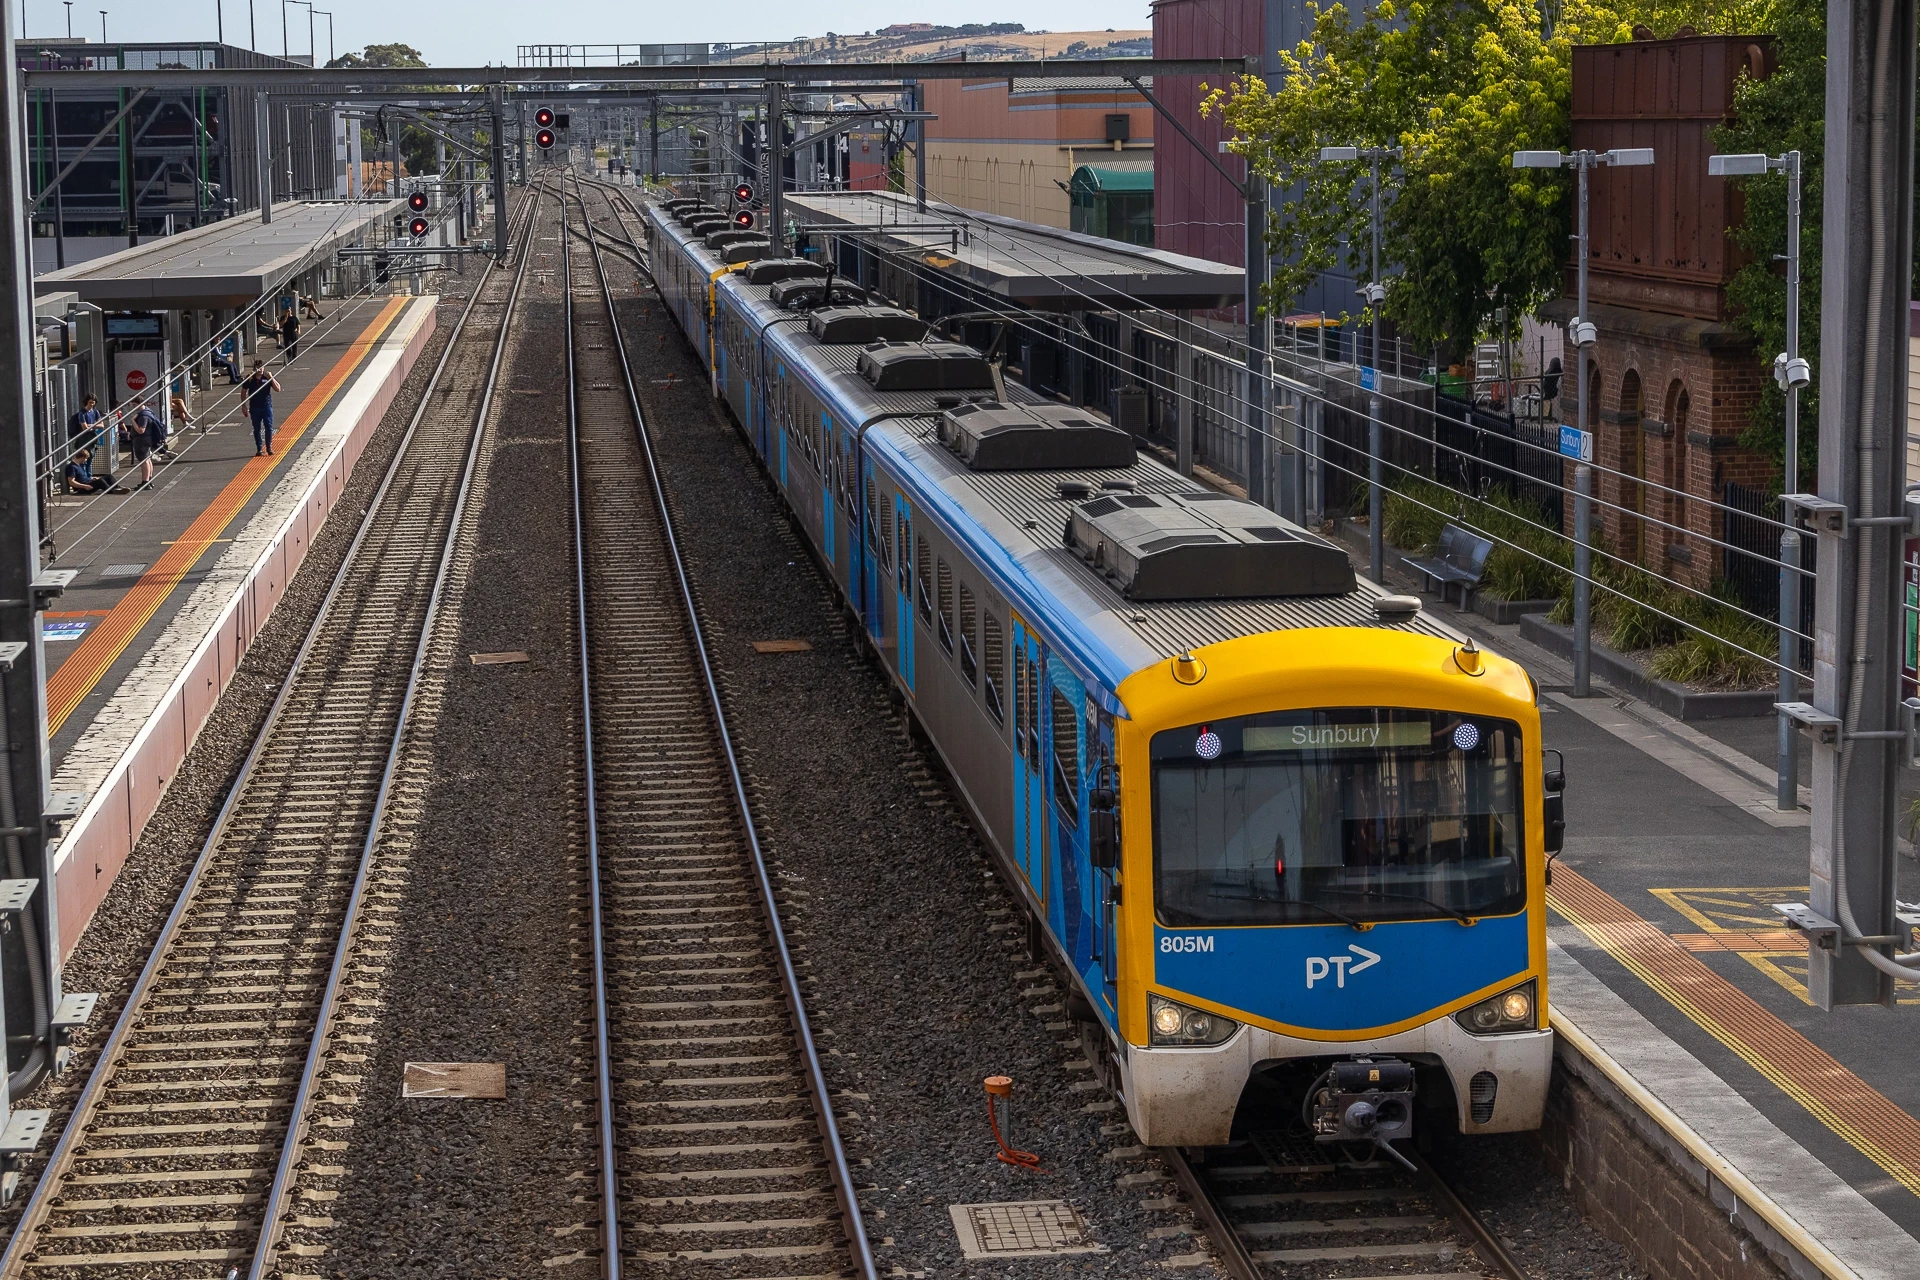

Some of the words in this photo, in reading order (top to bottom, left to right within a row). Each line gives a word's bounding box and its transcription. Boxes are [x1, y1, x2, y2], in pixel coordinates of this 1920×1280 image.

[1561, 430, 1580, 452] Sunbury
[1582, 434, 1588, 459] 2
[1291, 724, 1380, 747] Sunbury
[1160, 935, 1214, 953] 805M
